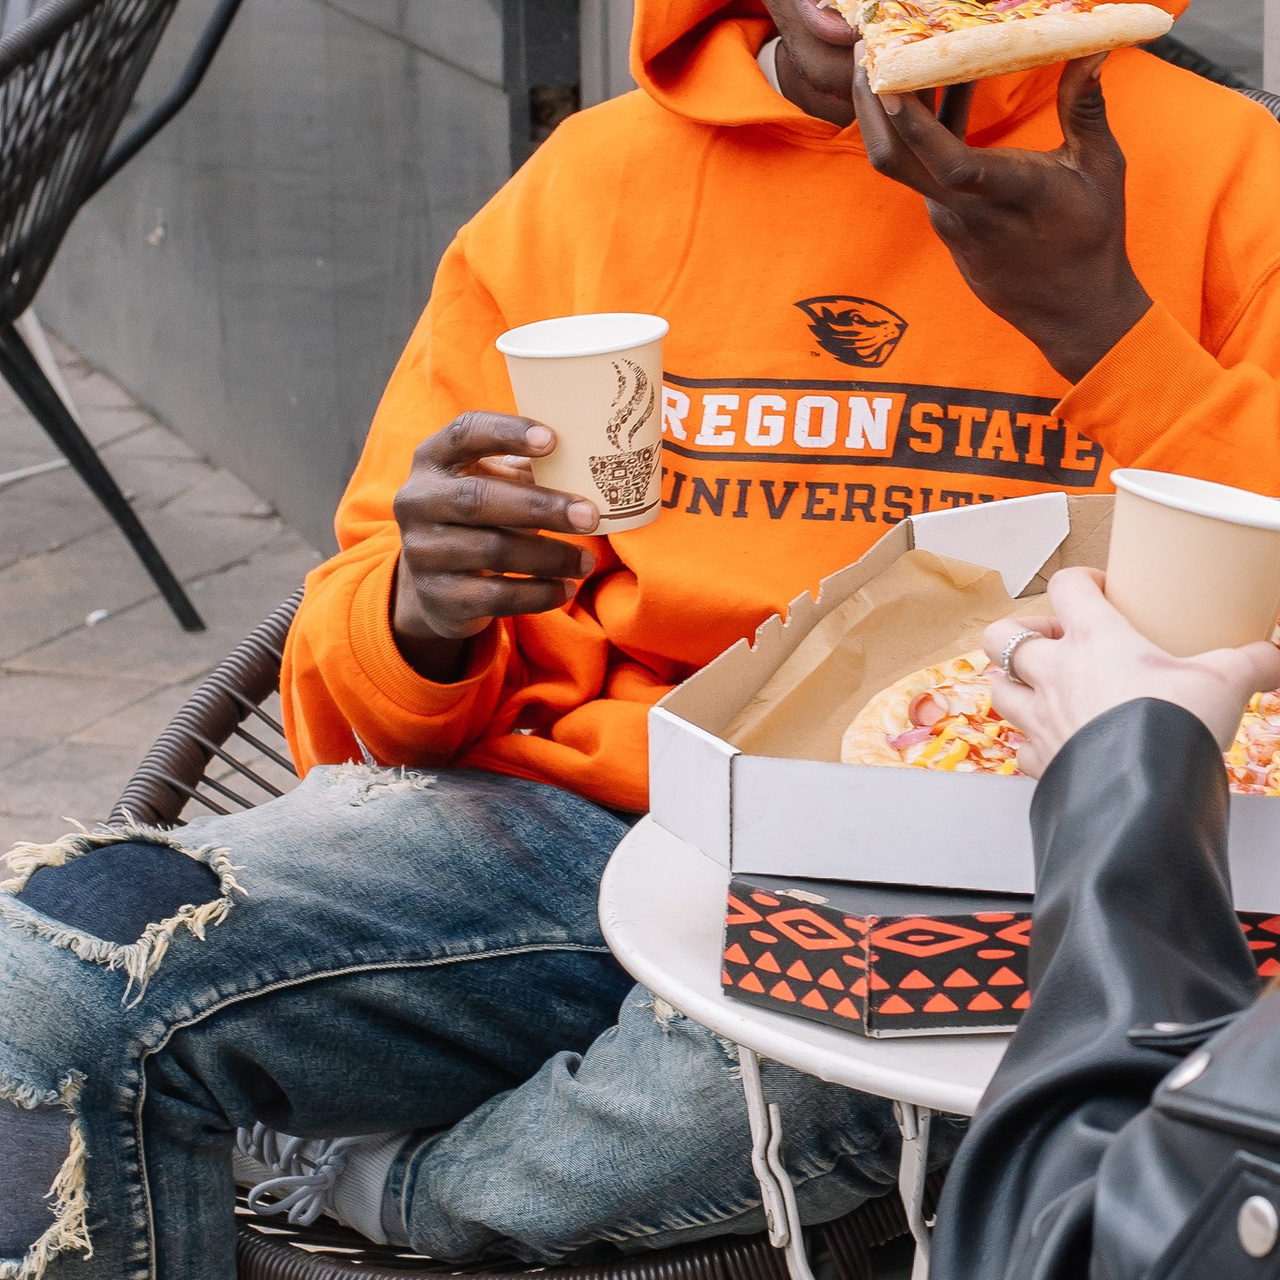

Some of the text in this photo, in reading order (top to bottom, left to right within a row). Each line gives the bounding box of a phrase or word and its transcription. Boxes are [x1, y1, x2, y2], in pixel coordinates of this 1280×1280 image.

[661, 386, 1099, 472] REGON STATE
[661, 467, 1012, 525] UNIVERSIT
